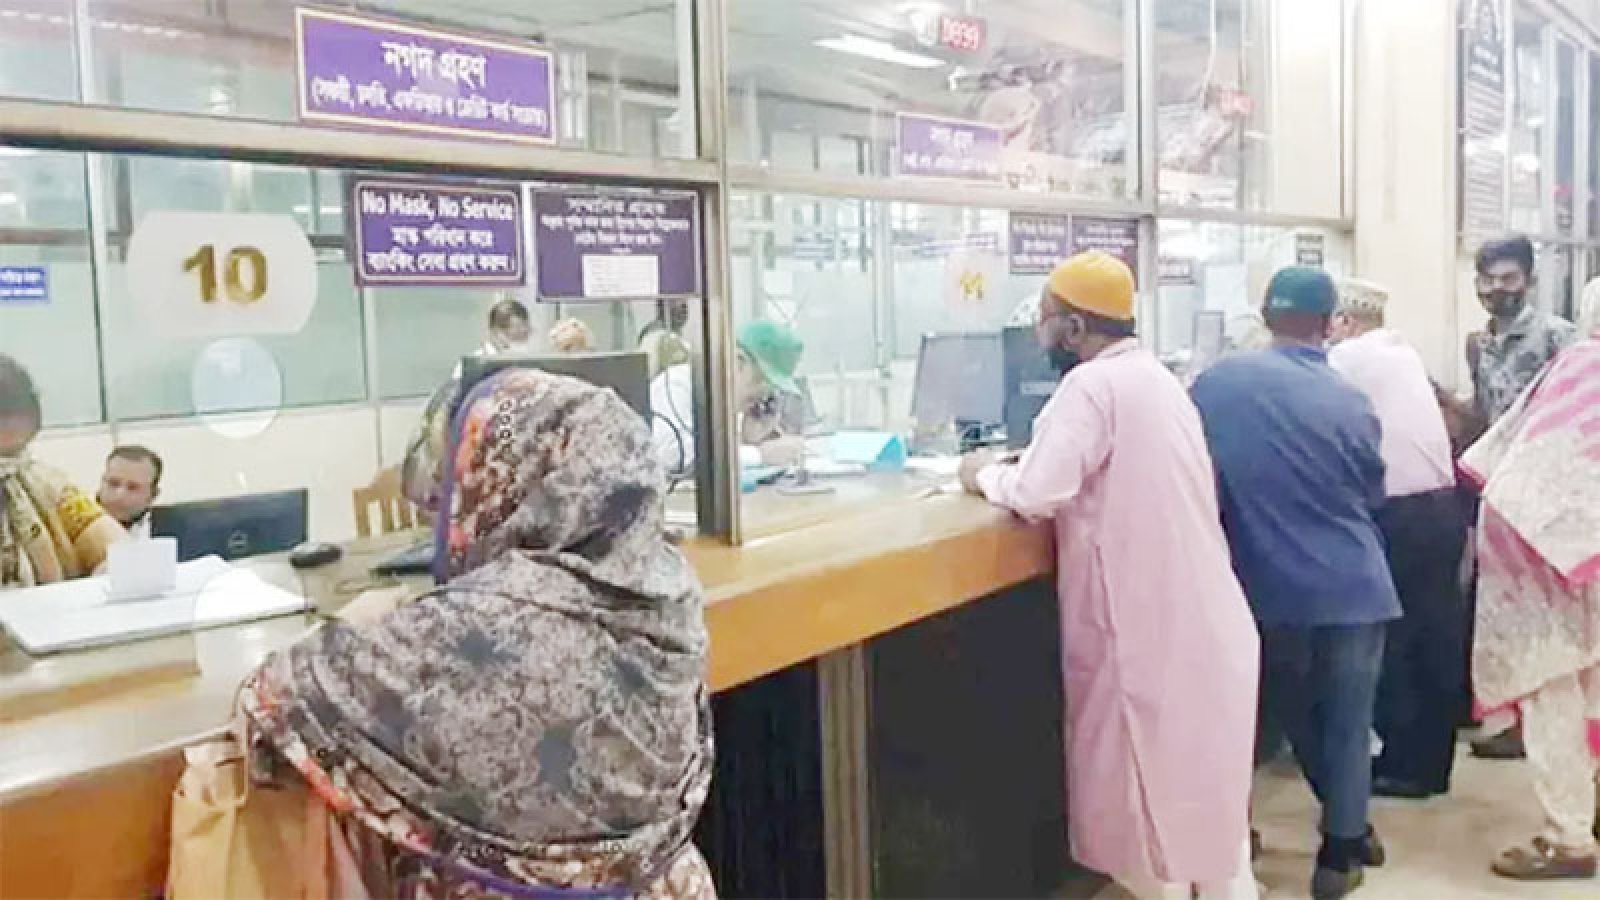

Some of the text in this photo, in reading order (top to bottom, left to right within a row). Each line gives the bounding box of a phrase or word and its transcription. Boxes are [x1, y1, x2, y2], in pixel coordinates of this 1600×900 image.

[379, 40, 487, 90] নগদ গ্রহণ
[362, 190, 513, 220] No Mask, No Service
[391, 226, 419, 246] মাস্ক
[422, 222, 466, 247] পরিধান
[181, 243, 268, 304] 10
[417, 252, 446, 272] সেবা
